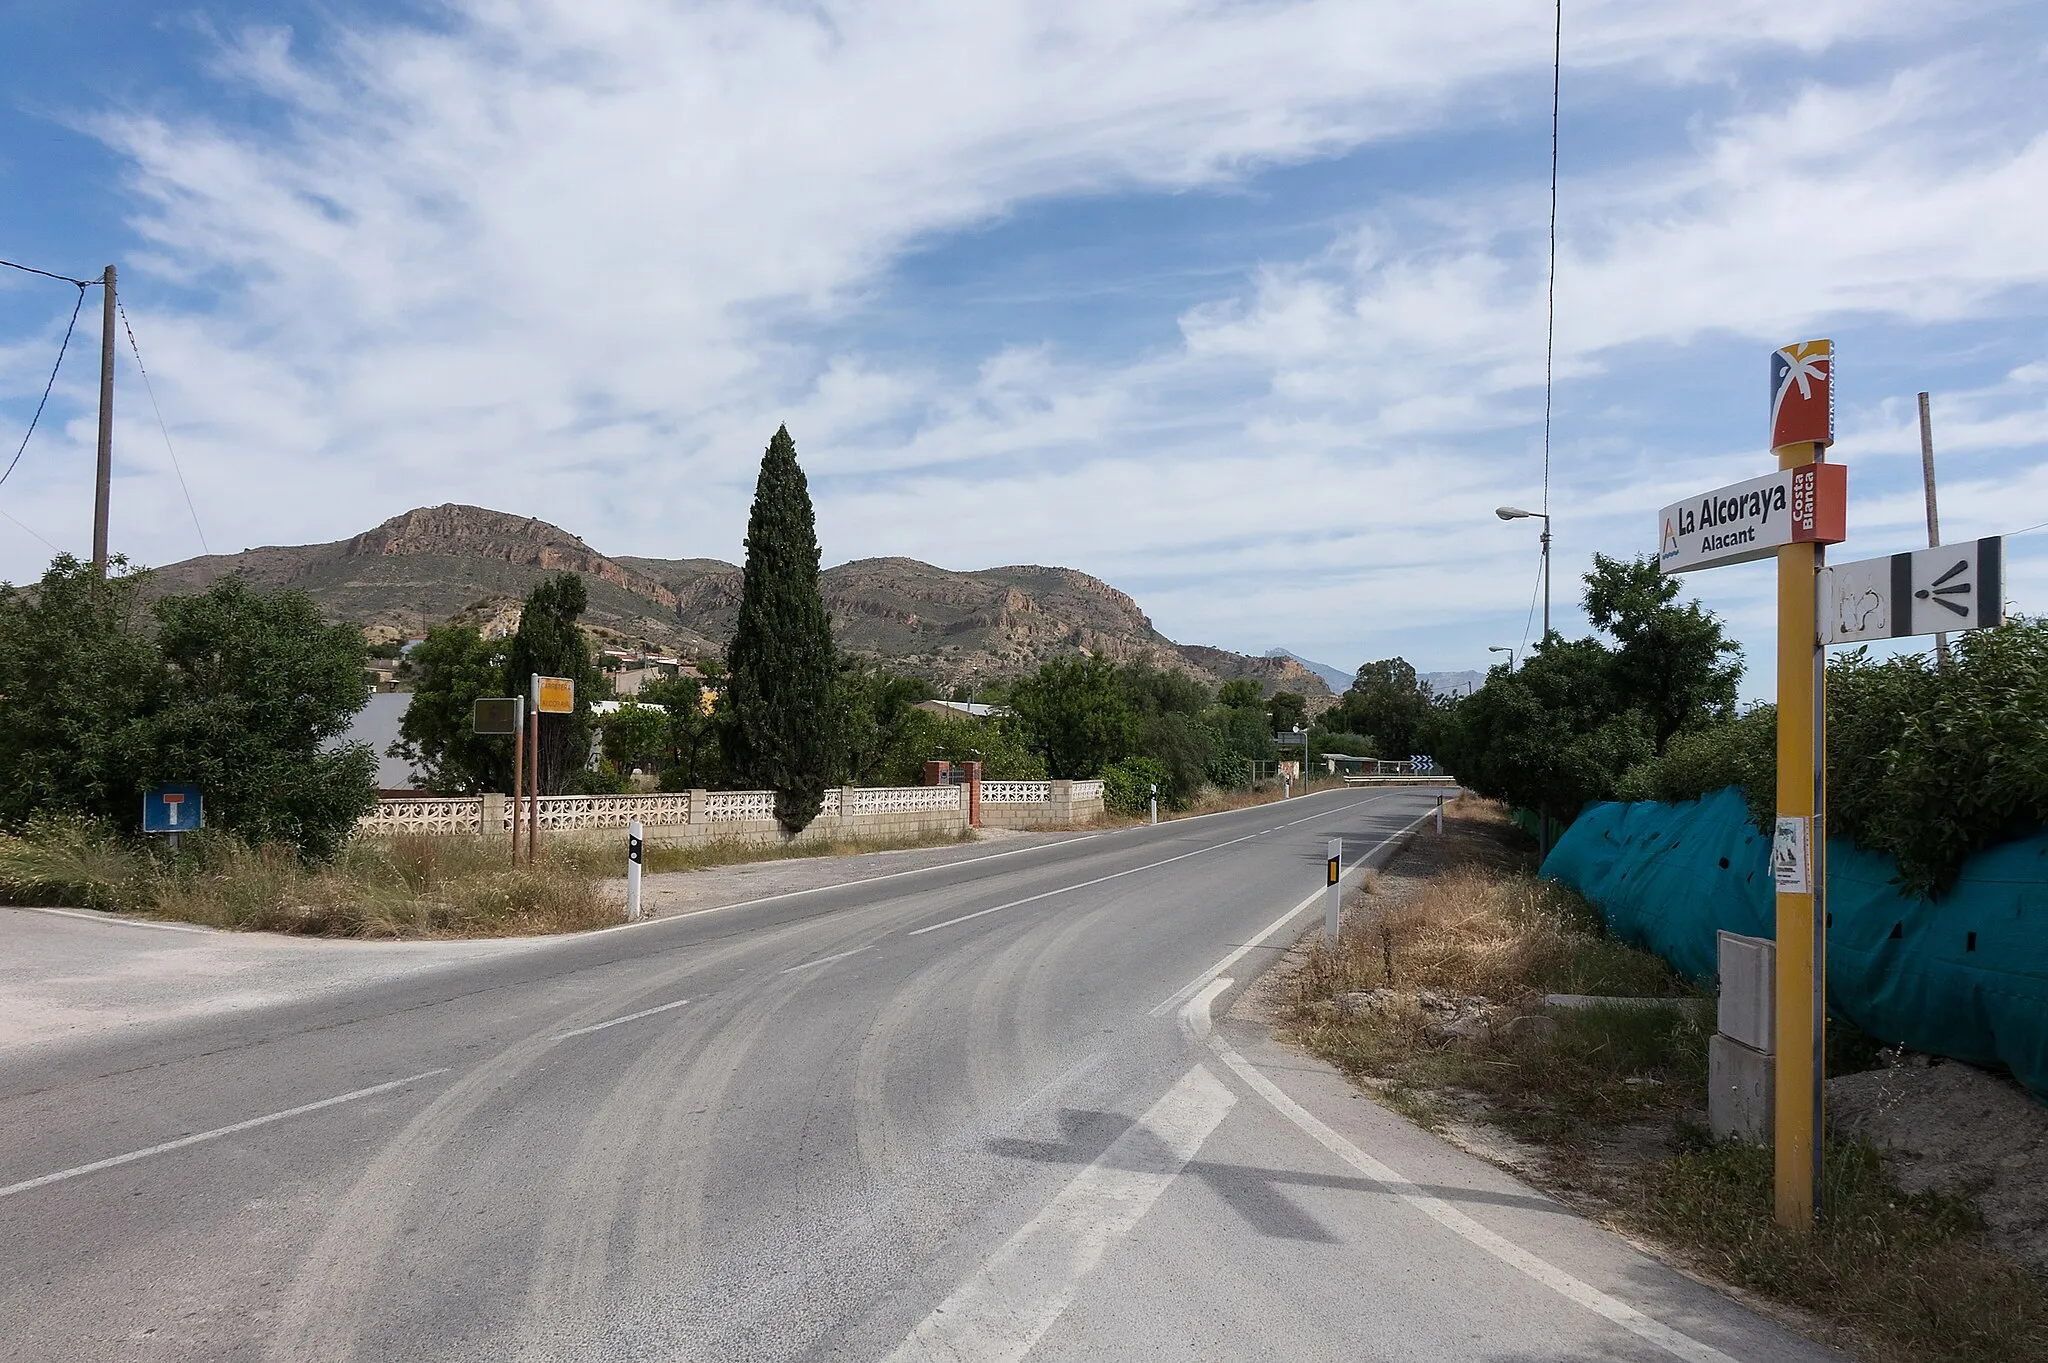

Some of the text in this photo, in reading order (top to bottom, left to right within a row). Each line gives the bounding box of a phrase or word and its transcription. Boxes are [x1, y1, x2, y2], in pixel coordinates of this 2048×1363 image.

[1679, 484, 1786, 537] La Alcoraya
[1792, 473, 1804, 522] Costa
[1802, 471, 1814, 530] Blanca
[1701, 525, 1755, 553] Alacant
